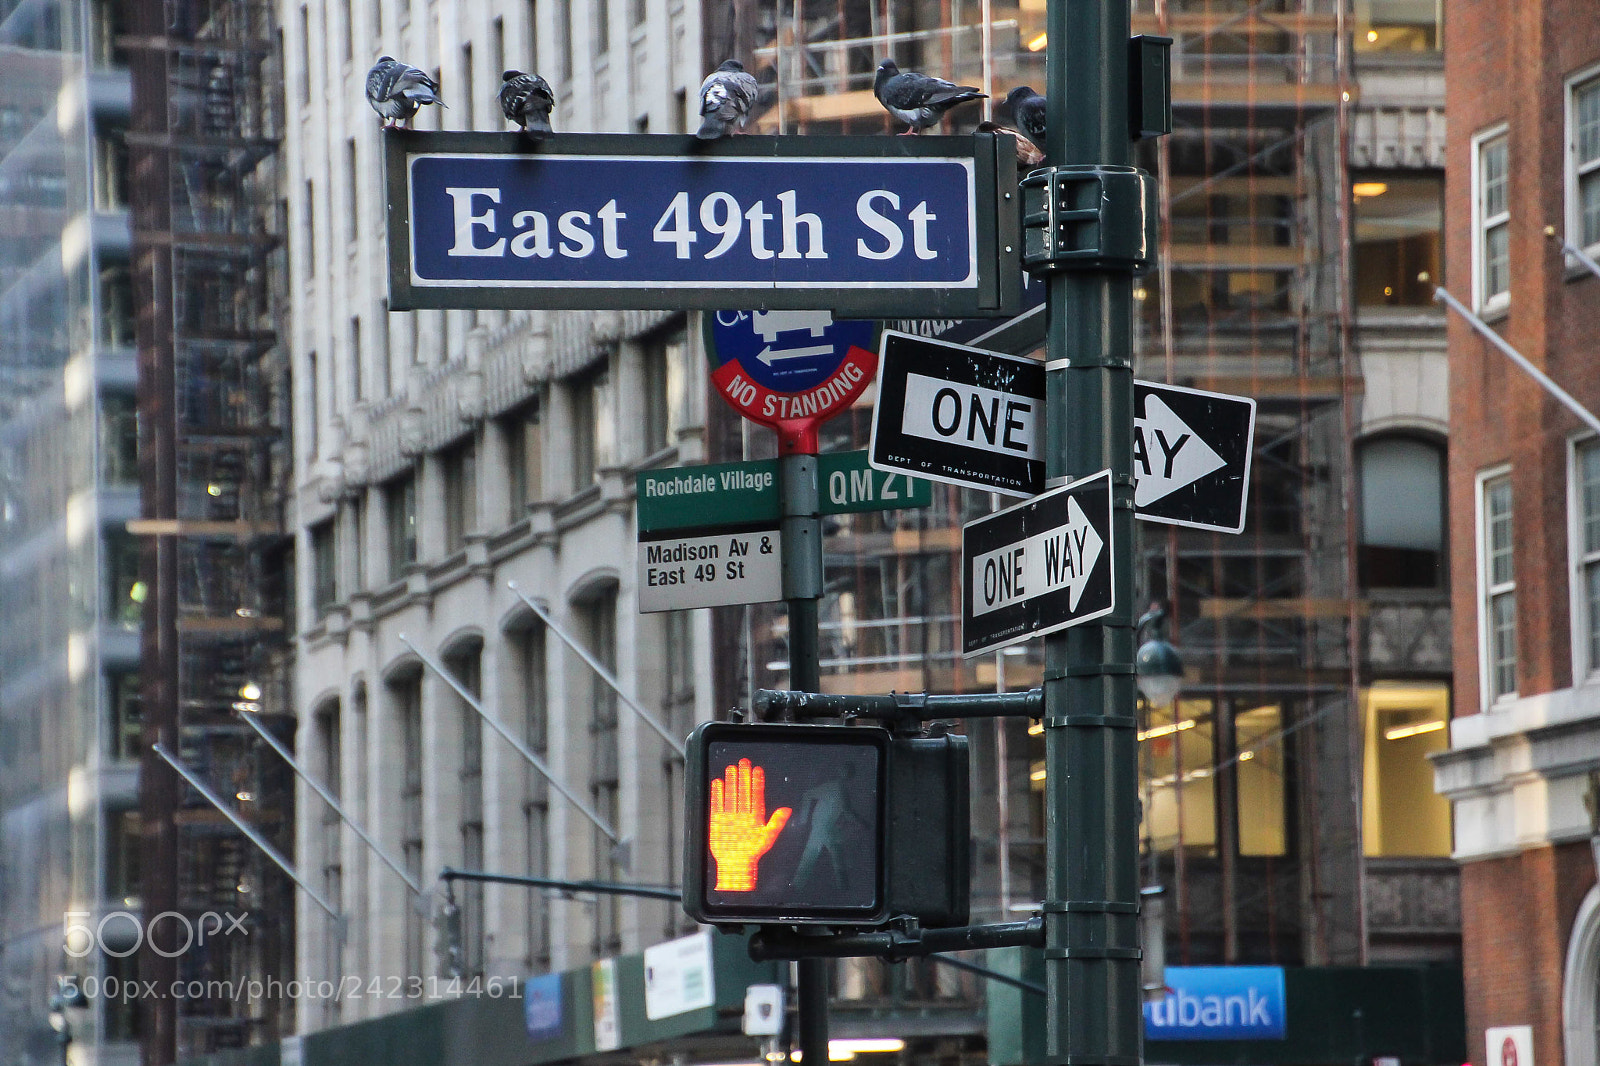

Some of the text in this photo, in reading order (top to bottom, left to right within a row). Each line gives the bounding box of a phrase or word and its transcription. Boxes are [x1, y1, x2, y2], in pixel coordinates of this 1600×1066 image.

[446, 187, 938, 261] East 49th St
[725, 362, 864, 418] NO STANDING
[932, 387, 1191, 479] ONE AY
[646, 470, 772, 497] Rochdale Village
[888, 454, 911, 464] DEPT
[942, 465, 1021, 486] TRANSPORTATION
[647, 536, 773, 564] Madison Av &
[984, 525, 1088, 607] ONE WAY
[647, 560, 745, 587] East 49 St
